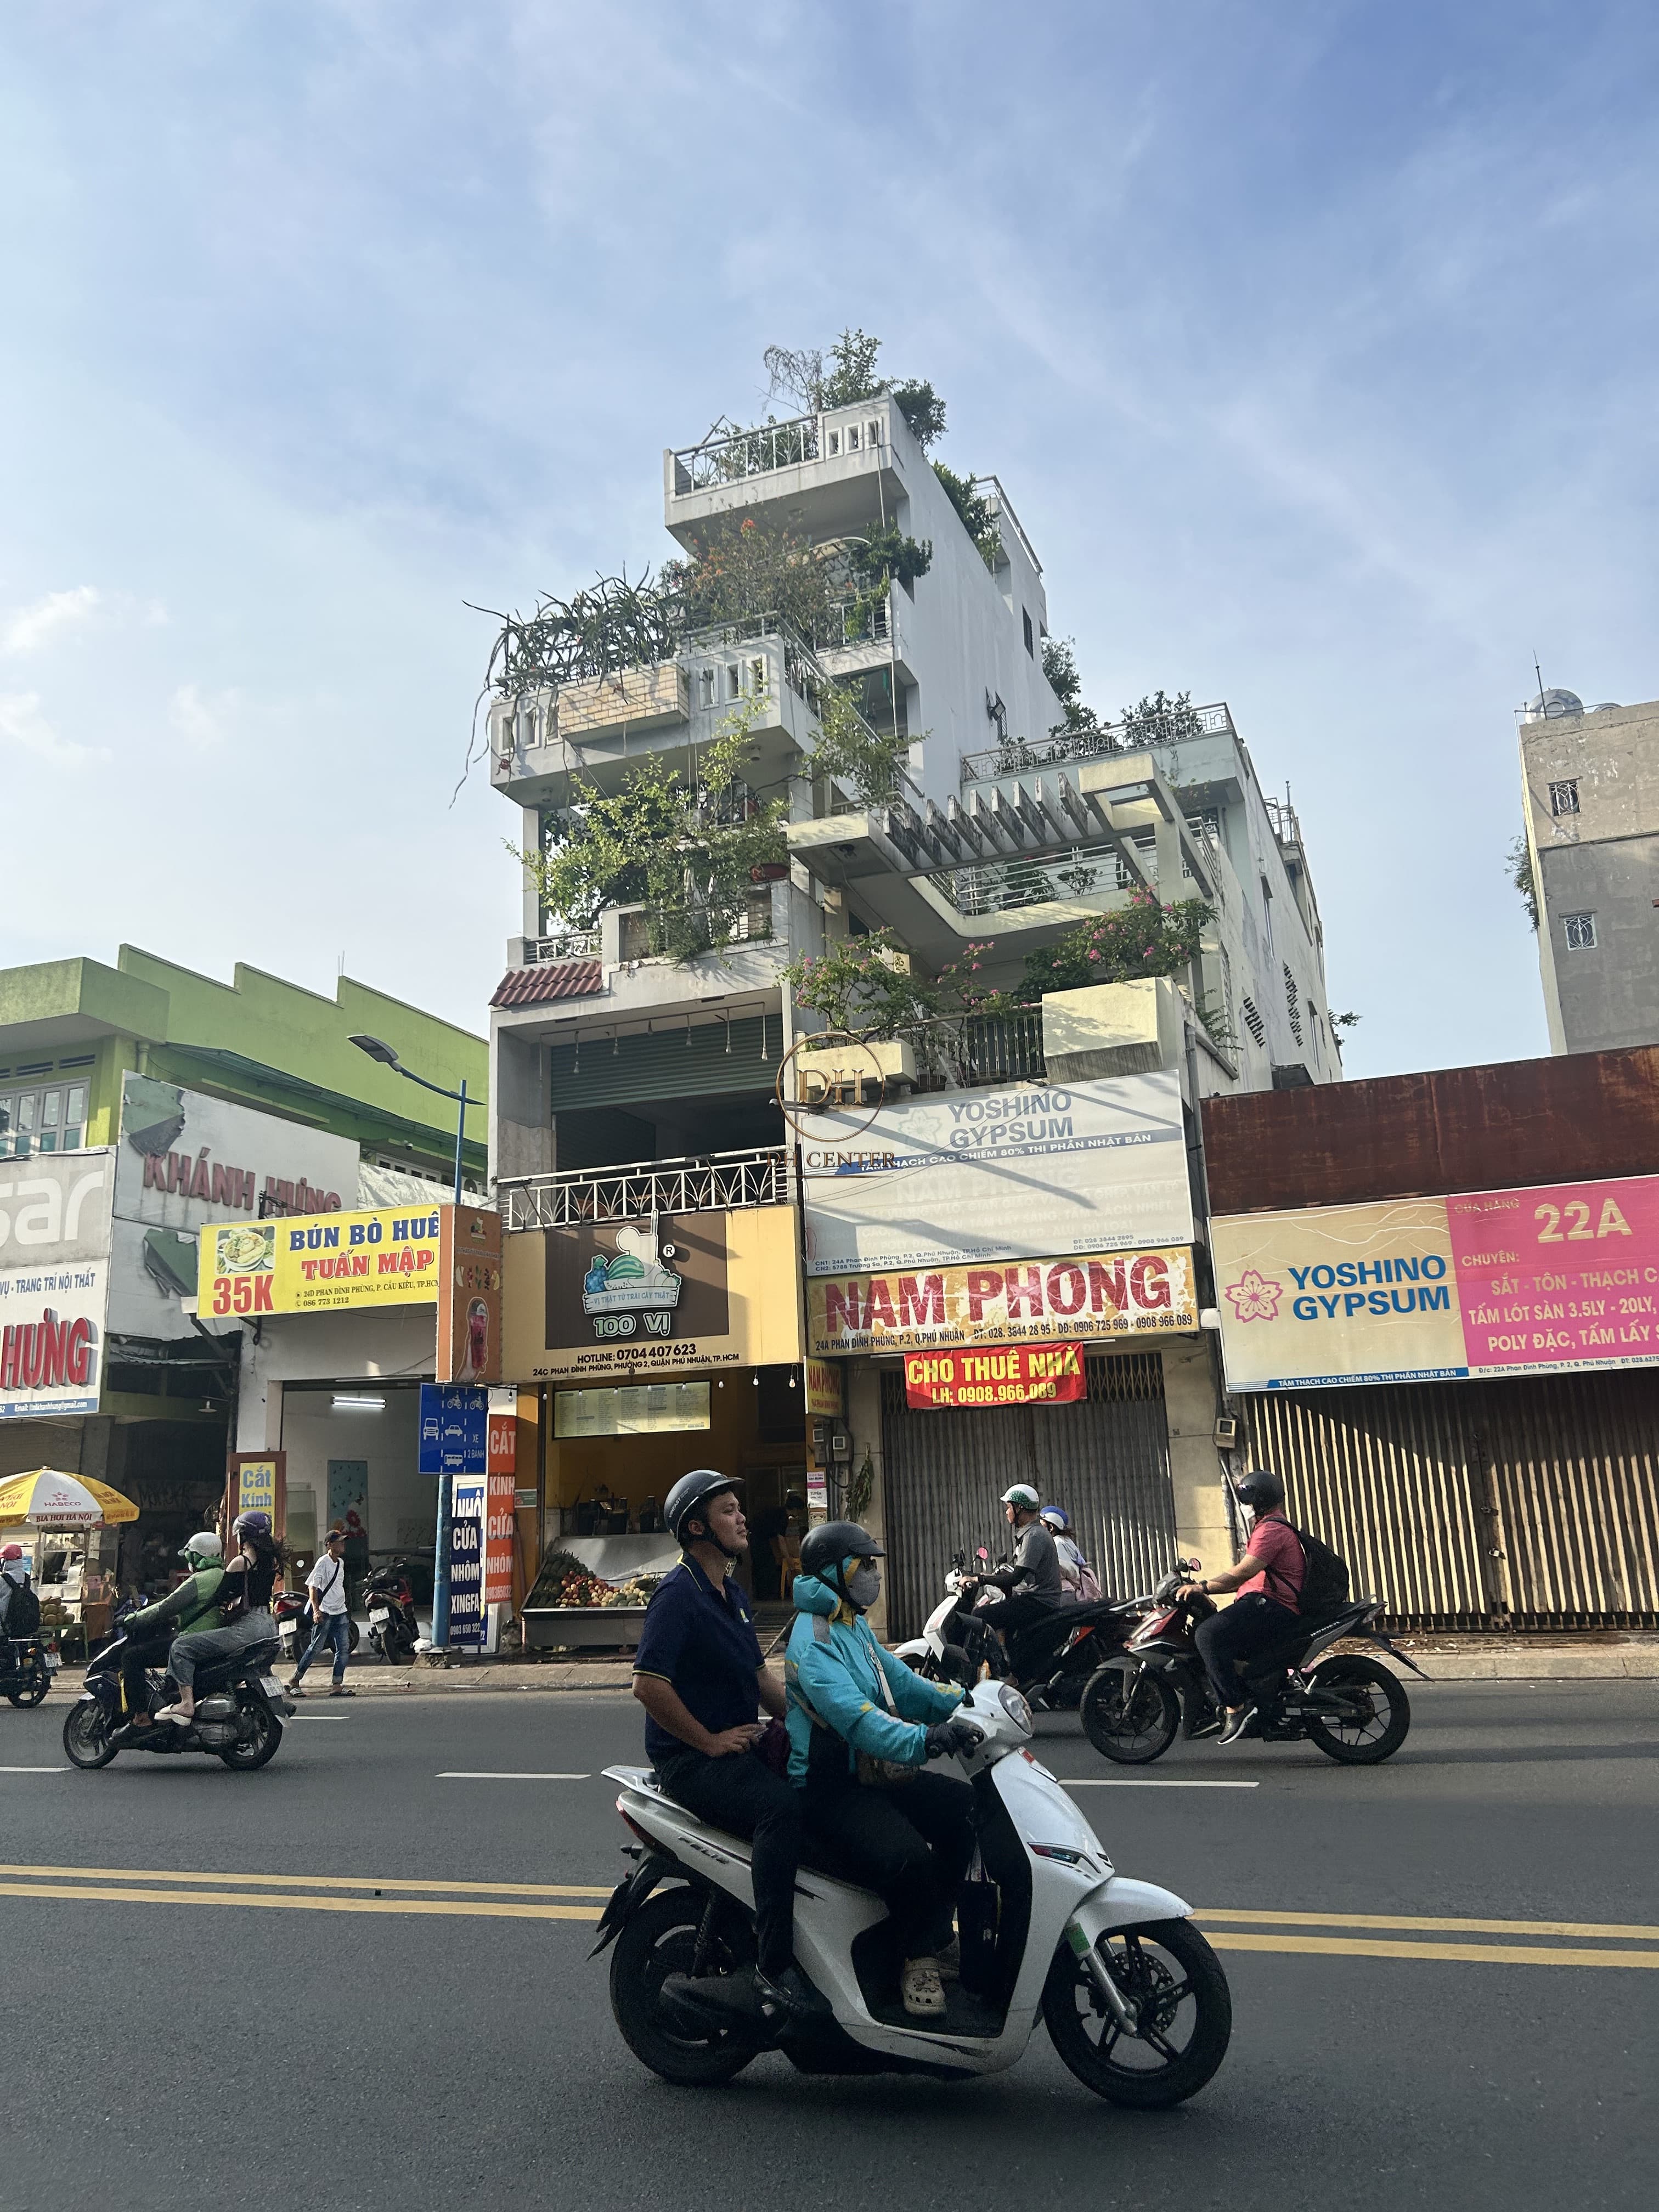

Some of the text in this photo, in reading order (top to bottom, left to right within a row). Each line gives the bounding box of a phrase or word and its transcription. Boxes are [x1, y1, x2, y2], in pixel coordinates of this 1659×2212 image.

[947, 1091, 1072, 1124] YOSHINO
[949, 1116, 1074, 1151] GYPSUM
[929, 1154, 956, 1163] CAO
[959, 1148, 997, 1160] CHIẾM
[1001, 1147, 1025, 1156] 80%
[1028, 1144, 1047, 1155] THỊ
[1088, 1136, 1122, 1148] NHẬT
[143, 1147, 256, 1210] KHÁNH
[290, 1223, 340, 1251] BÚN
[349, 1217, 382, 1245] BÒ
[1534, 1198, 1633, 1243] 22A
[301, 1249, 370, 1280] TUẤN
[378, 1245, 434, 1277] MẬP
[1462, 1249, 1520, 1267] CHUYÊN:
[16, 1277, 42, 1294] TRANG
[44, 1272, 57, 1291] TRÍ
[59, 1272, 72, 1294] NỘI
[75, 1268, 96, 1289] THẤT
[1288, 1255, 1447, 1290] YOSHINO
[1491, 1268, 1640, 1296] SẮT TÔN THẠCH
[213, 1274, 275, 1315] 35K
[316, 1288, 332, 1296] PHAN
[826, 1255, 1172, 1333] NAM PHONG
[1292, 1285, 1451, 1322] GYPSUM
[1469, 1295, 1657, 1326] TẤM LÓT SÀN 3.5LY 20LY,
[594, 1312, 670, 1338] 100 VỊ
[816, 1339, 829, 1351] 24A
[832, 1338, 850, 1350] PHAN
[871, 1332, 897, 1346] PHÙNG,
[915, 1329, 937, 1344] Q.PHÚ
[939, 1327, 964, 1342] NHUẬN
[988, 1327, 1006, 1339] 028.
[1007, 1325, 1027, 1338] 3844
[1029, 1324, 1039, 1336] 28
[1041, 1324, 1051, 1335] 95
[1074, 1320, 1094, 1333] 0906
[1097, 1319, 1111, 1331] 725
[1113, 1318, 1129, 1330] 969
[1136, 1317, 1157, 1329] 0908
[1159, 1315, 1175, 1327] 966
[1177, 1314, 1193, 1326] 089
[1487, 1334, 1527, 1352] POLY
[1533, 1328, 1576, 1352] ĐẶC,
[1578, 1321, 1616, 1346] TẤM
[1620, 1318, 1650, 1342] LẤY
[533, 1368, 549, 1376] 24C
[551, 1367, 569, 1375] PHAN
[589, 1361, 613, 1372] PHÙNG,
[651, 1357, 670, 1368] QUẬN
[673, 1355, 685, 1365] PHÚ
[687, 1354, 713, 1365] NHUẬN,
[578, 1353, 616, 1364] HOTLINE:
[908, 1345, 1081, 1385] CHO THUÊ NHÀ
[1494, 1364, 1505, 1373] 22A
[1506, 1363, 1522, 1372] Phan
[1295, 1378, 1320, 1387] THẠCH
[1322, 1377, 1337, 1385] CAO
[1363, 1374, 1380, 1382] 80%
[1381, 1373, 1394, 1382] THỊ
[1418, 1370, 1439, 1379] NHẬT
[933, 1381, 1057, 1404] LH: 0908.966.089
[473, 1434, 479, 1443] XE
[490, 1421, 516, 1455] CẮT
[467, 1446, 484, 1459] 2 BÁNH
[243, 1465, 272, 1489] Cắt
[489, 1472, 515, 1496] KÍNH
[241, 1492, 272, 1508] Kính
[454, 1519, 477, 1551] CỬA
[488, 1508, 514, 1540] CỬA
[451, 1560, 480, 1583] NHÔM
[487, 1553, 514, 1575] NHÔM
[451, 1593, 480, 1614] XINGFA
